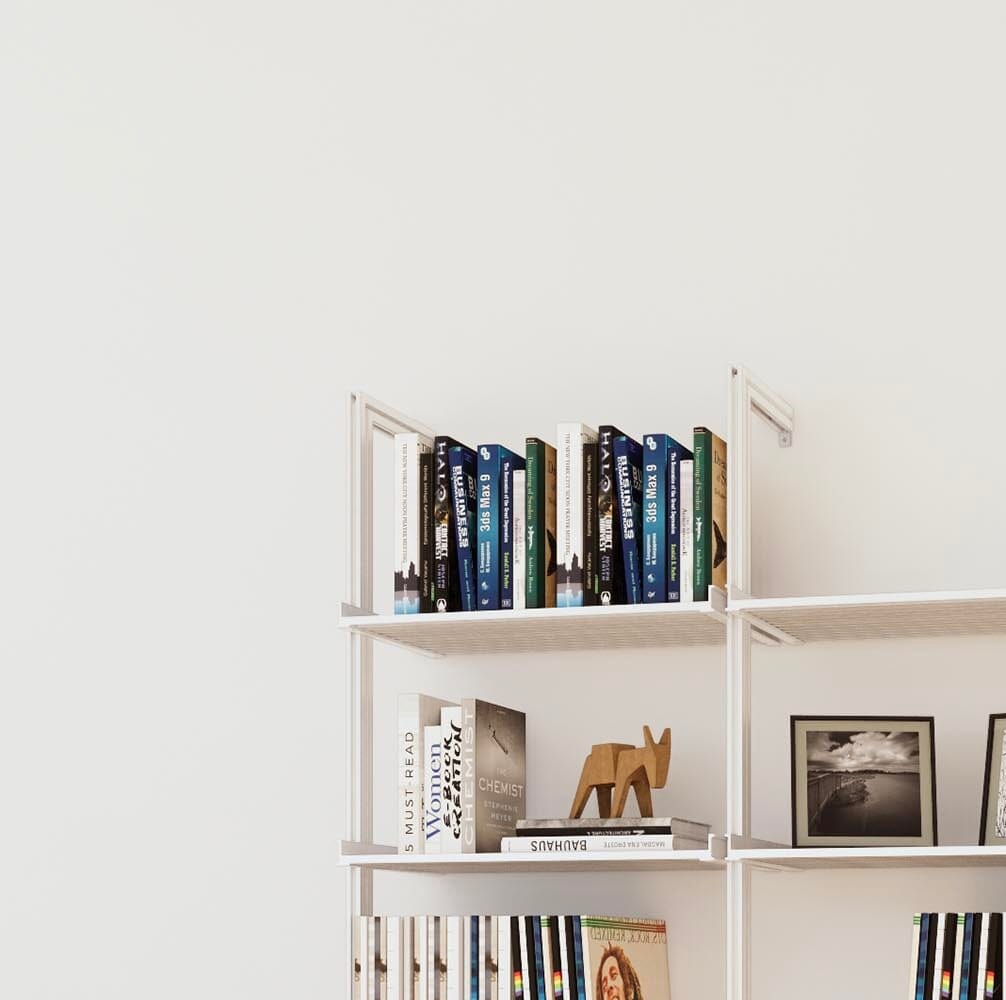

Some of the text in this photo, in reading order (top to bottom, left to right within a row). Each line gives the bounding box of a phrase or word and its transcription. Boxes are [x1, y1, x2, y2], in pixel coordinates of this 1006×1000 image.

[455, 465, 468, 548] BUSINESS
[480, 484, 490, 508] Max
[620, 456, 634, 540] BUSINESS
[646, 475, 657, 499] Max
[646, 502, 657, 523] 3ds
[480, 511, 490, 532] 3ds
[426, 744, 441, 840] Women
[443, 732, 452, 828] E-BOOK
[451, 720, 462, 840] CREATION
[465, 708, 474, 845] CHEMIST
[478, 777, 523, 797] CHEMIST
[530, 840, 587, 852] BAUHAUS
